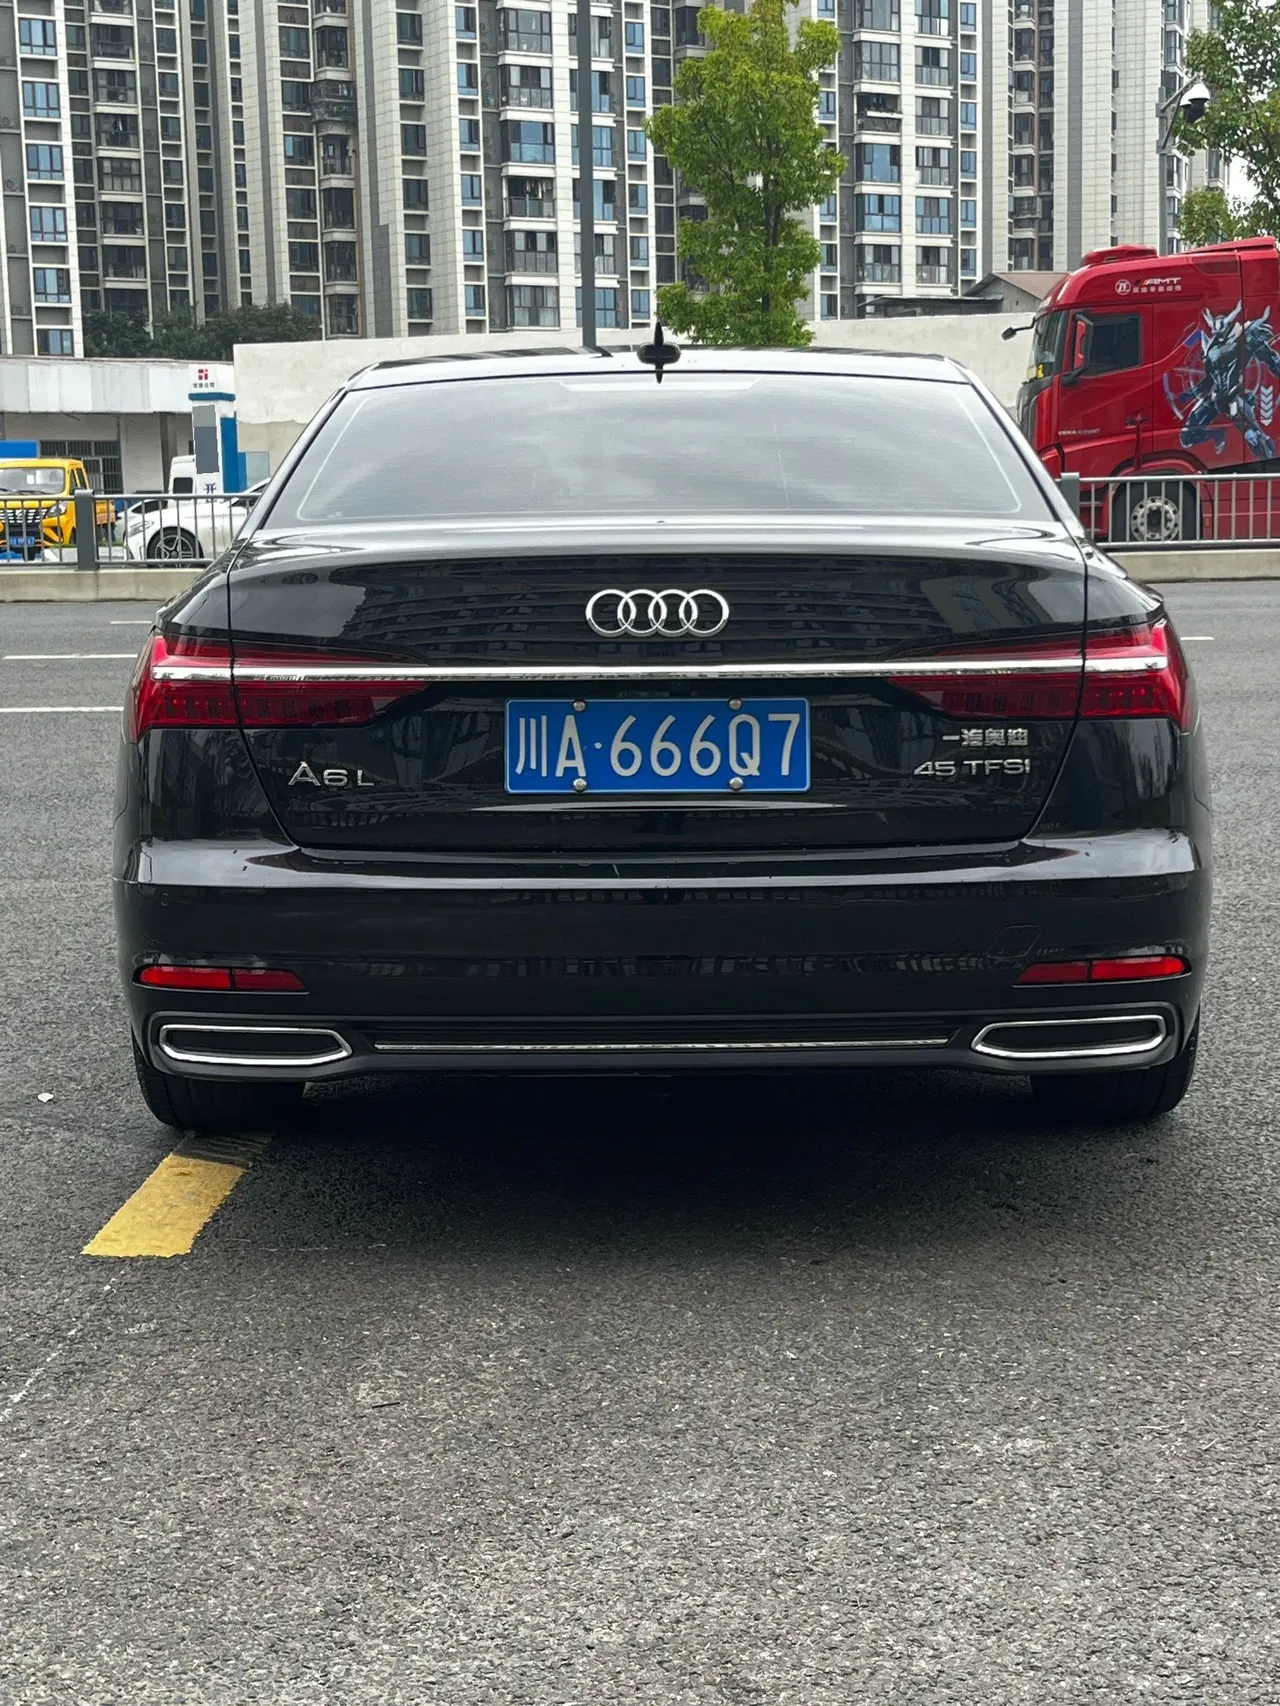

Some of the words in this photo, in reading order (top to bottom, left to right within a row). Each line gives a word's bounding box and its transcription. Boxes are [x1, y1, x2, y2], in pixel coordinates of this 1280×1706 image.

[942, 728, 1029, 746] 一汽奥迪
[913, 761, 956, 776] 45
[963, 758, 1030, 776] TFSI
